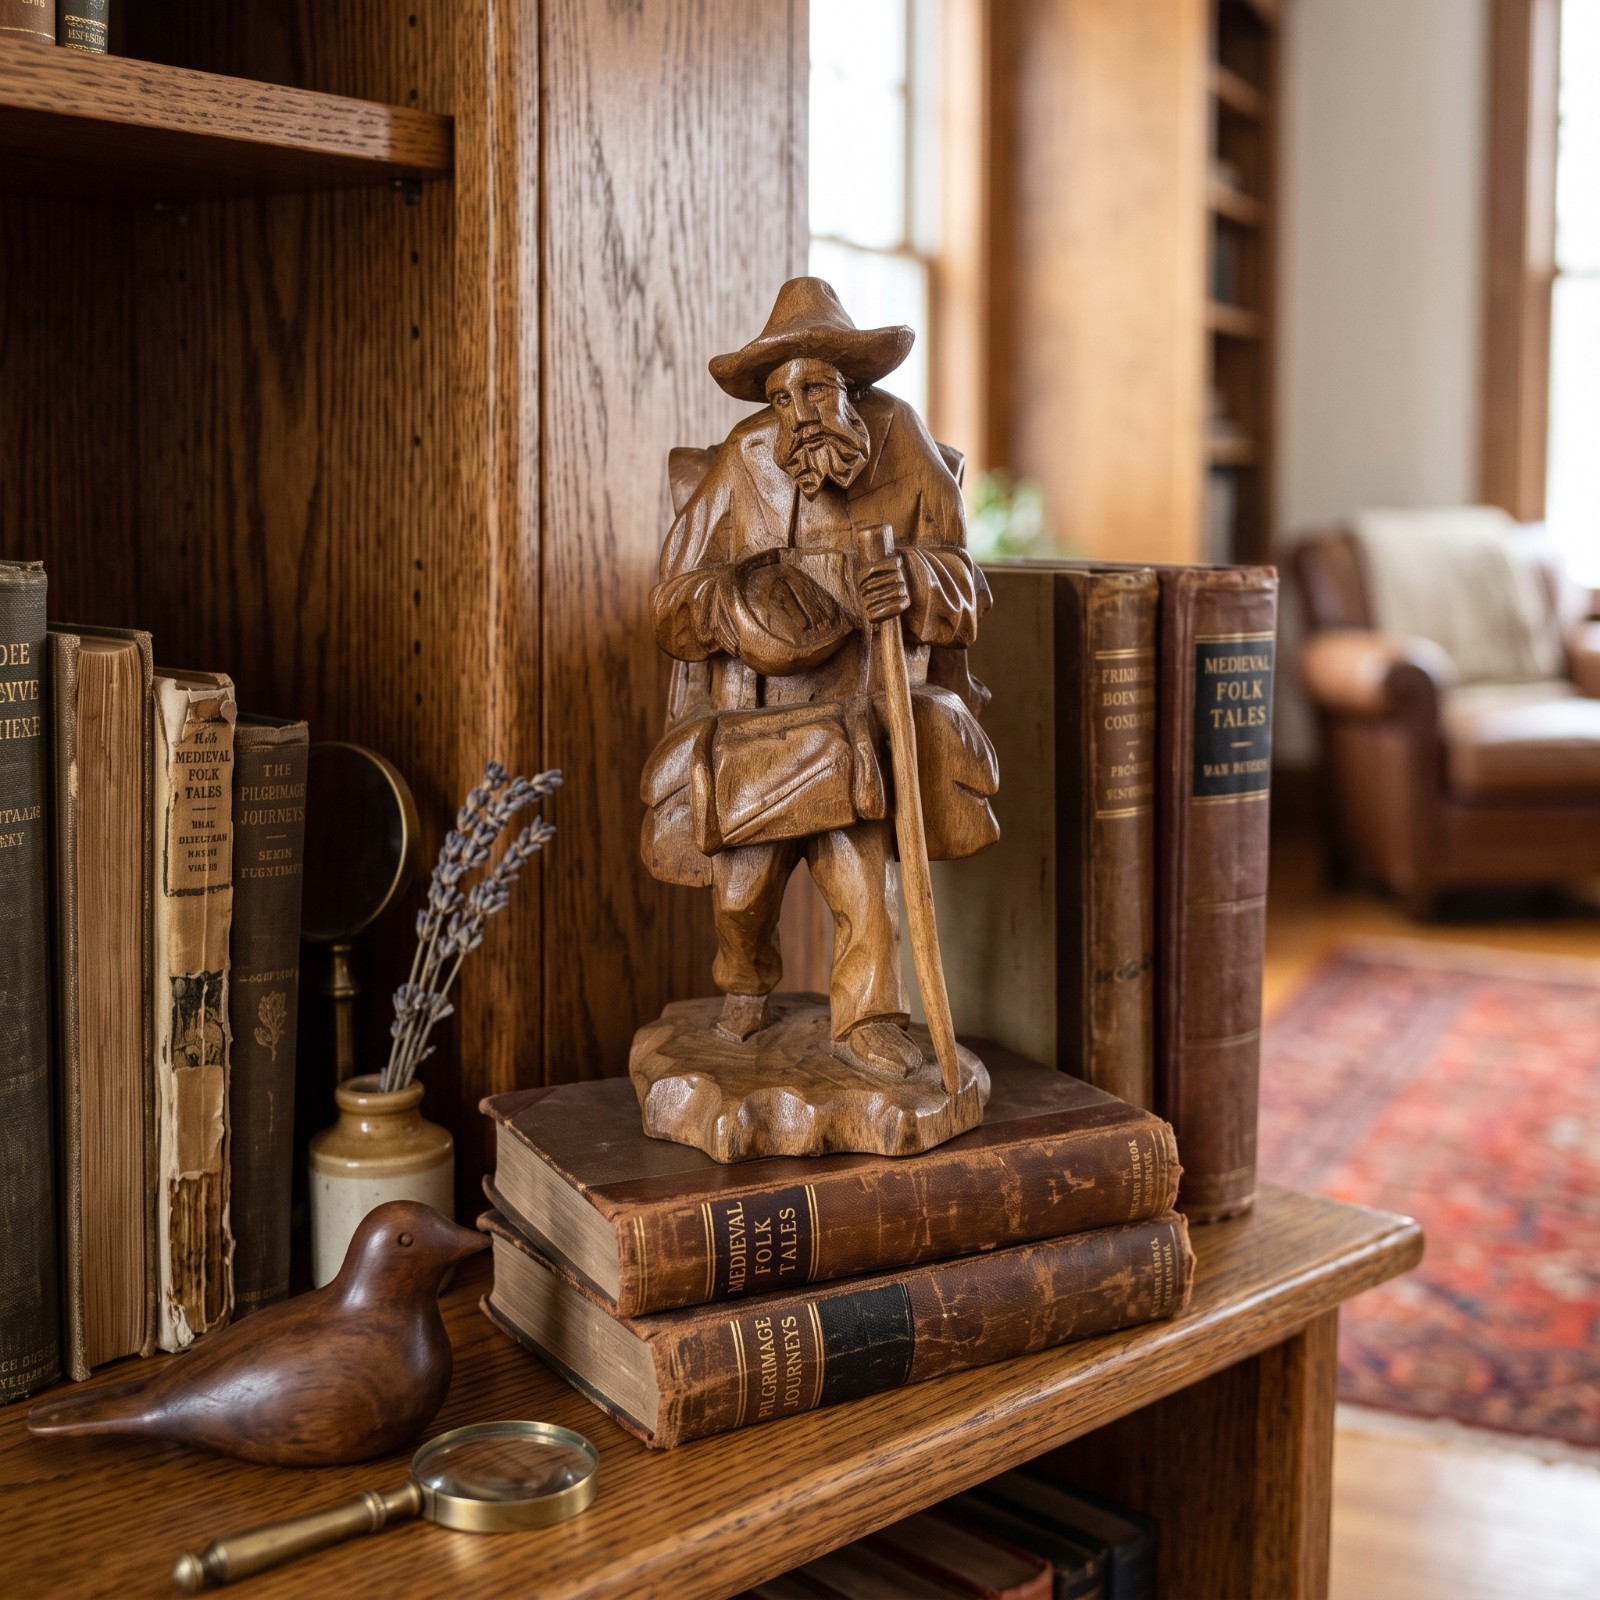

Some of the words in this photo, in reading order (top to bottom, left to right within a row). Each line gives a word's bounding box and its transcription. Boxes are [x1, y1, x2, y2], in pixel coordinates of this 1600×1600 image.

[1205, 655, 1270, 675] MEDIEVAL
[1216, 679, 1264, 702] FOLK
[1210, 705, 1266, 729] TALES
[175, 750, 231, 764] MEDIEVAL
[189, 768, 220, 781] FOLK
[263, 763, 292, 777] THE
[185, 785, 223, 799] TALES
[241, 806, 305, 826] JOURNEYS
[726, 1201, 747, 1294] MEDIEVAL
[754, 1217, 773, 1275] FOLK
[779, 1207, 797, 1275] TALES
[754, 1316, 777, 1418] PILGRIMAGE
[781, 1315, 802, 1407] JOURNEYS
